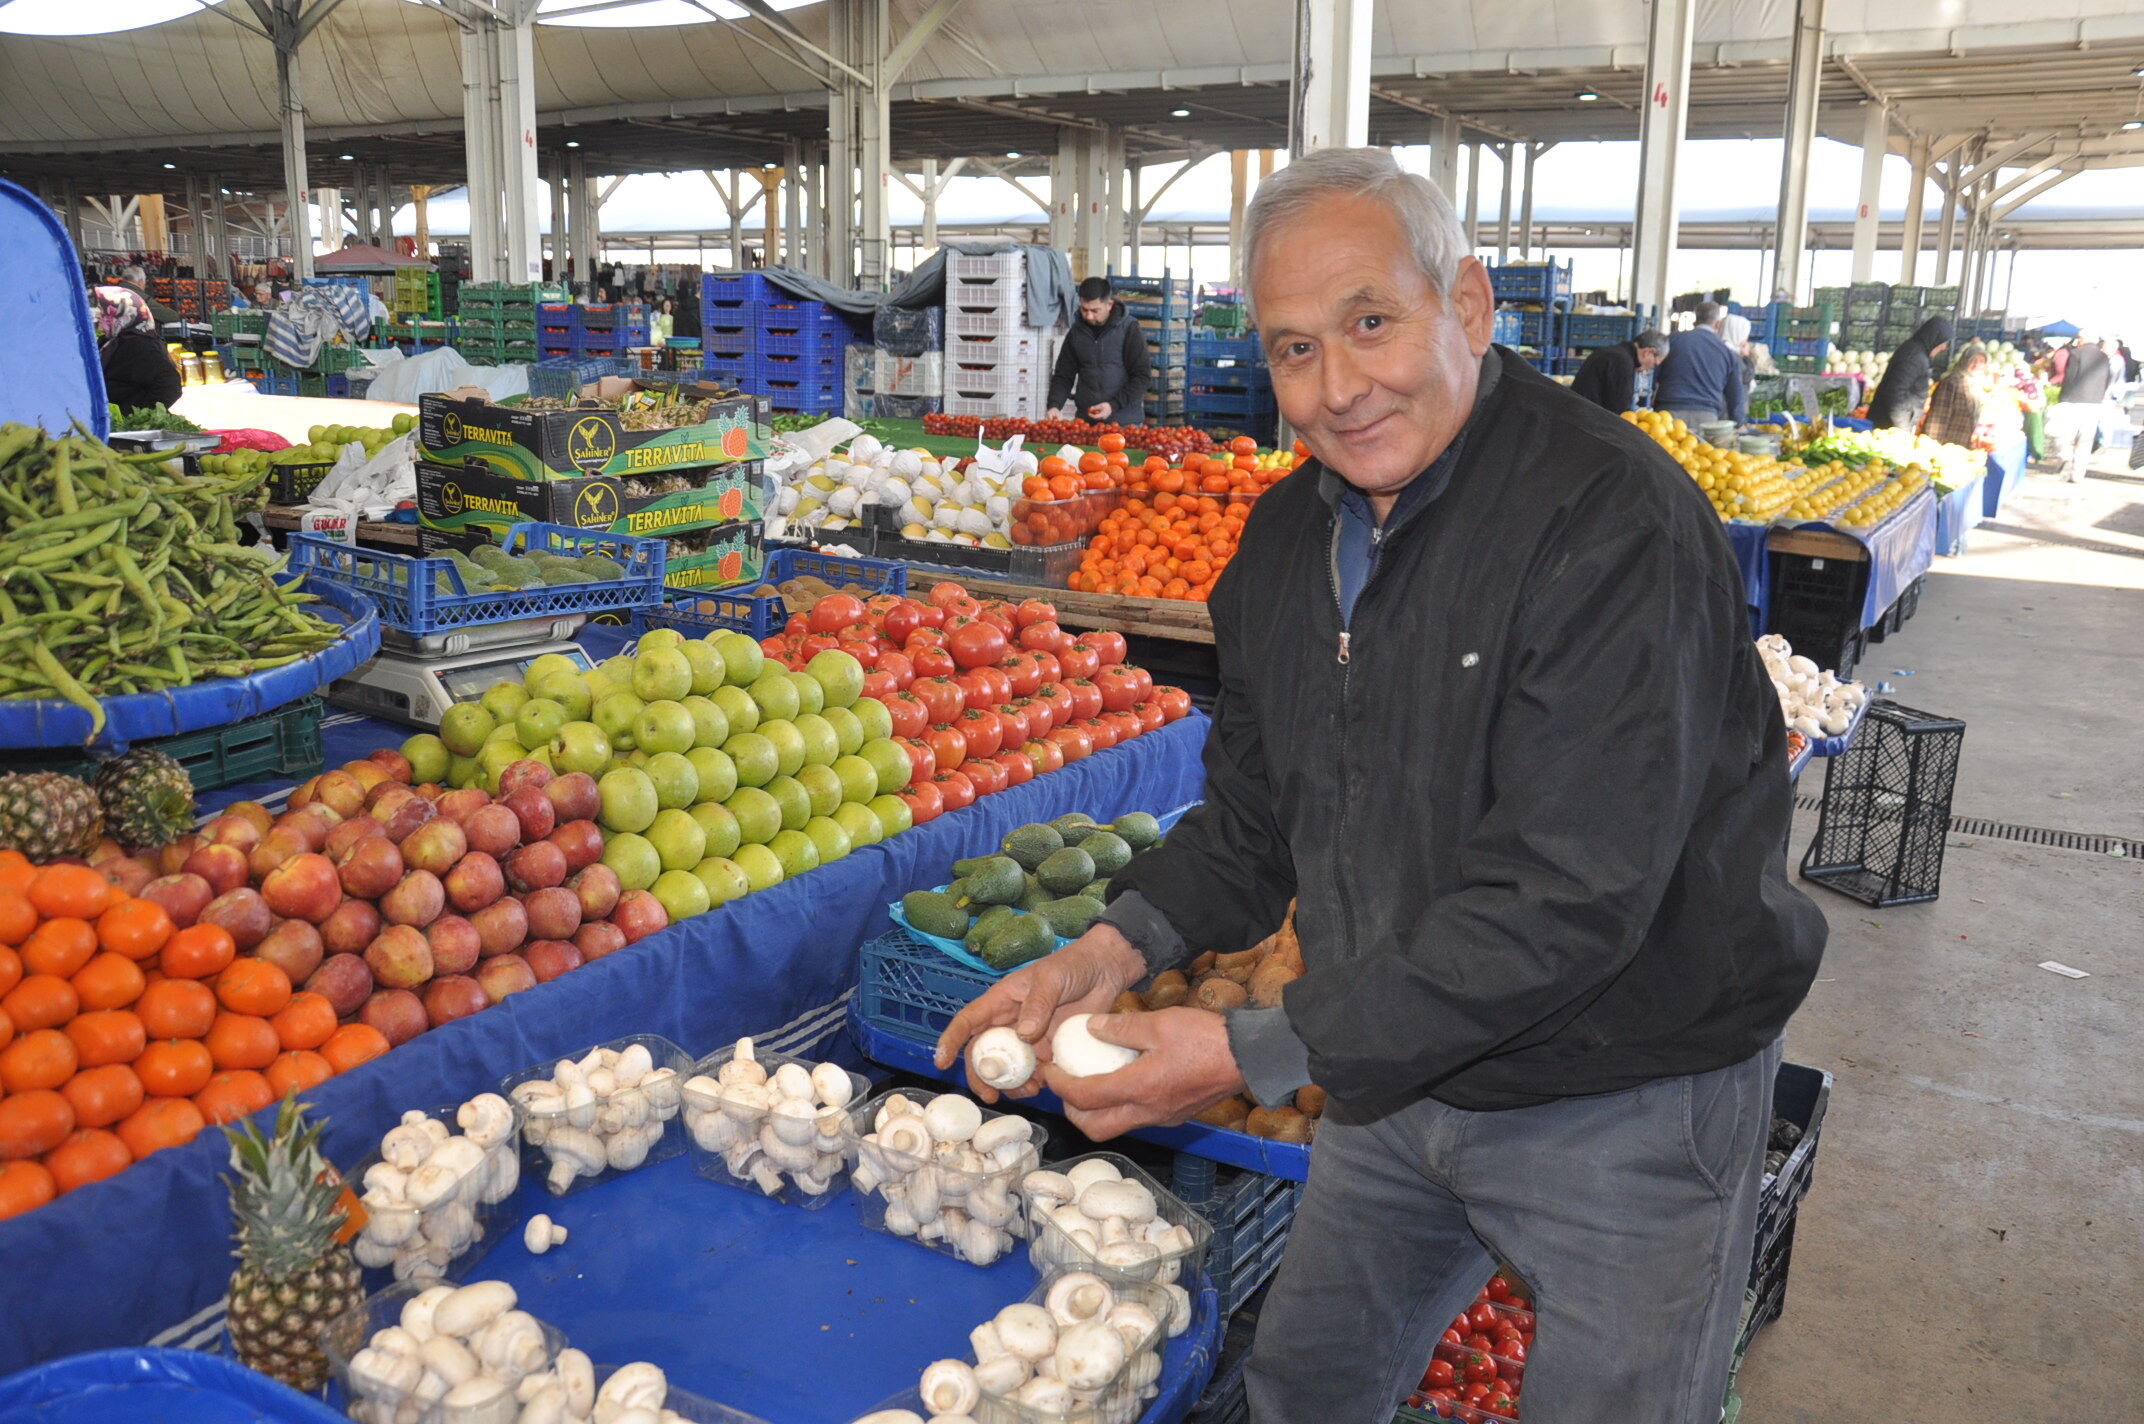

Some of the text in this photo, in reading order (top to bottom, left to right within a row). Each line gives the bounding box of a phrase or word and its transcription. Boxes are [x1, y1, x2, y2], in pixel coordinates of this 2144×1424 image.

[1653, 82, 1668, 108] 4
[300, 191, 307, 203] 5
[462, 424, 513, 447] TERRAVITA
[625, 441, 705, 468] TERRAVITA
[463, 493, 519, 517] TERRAVITA
[627, 504, 703, 532] TERRAVITA
[664, 568, 703, 588] AVITA
